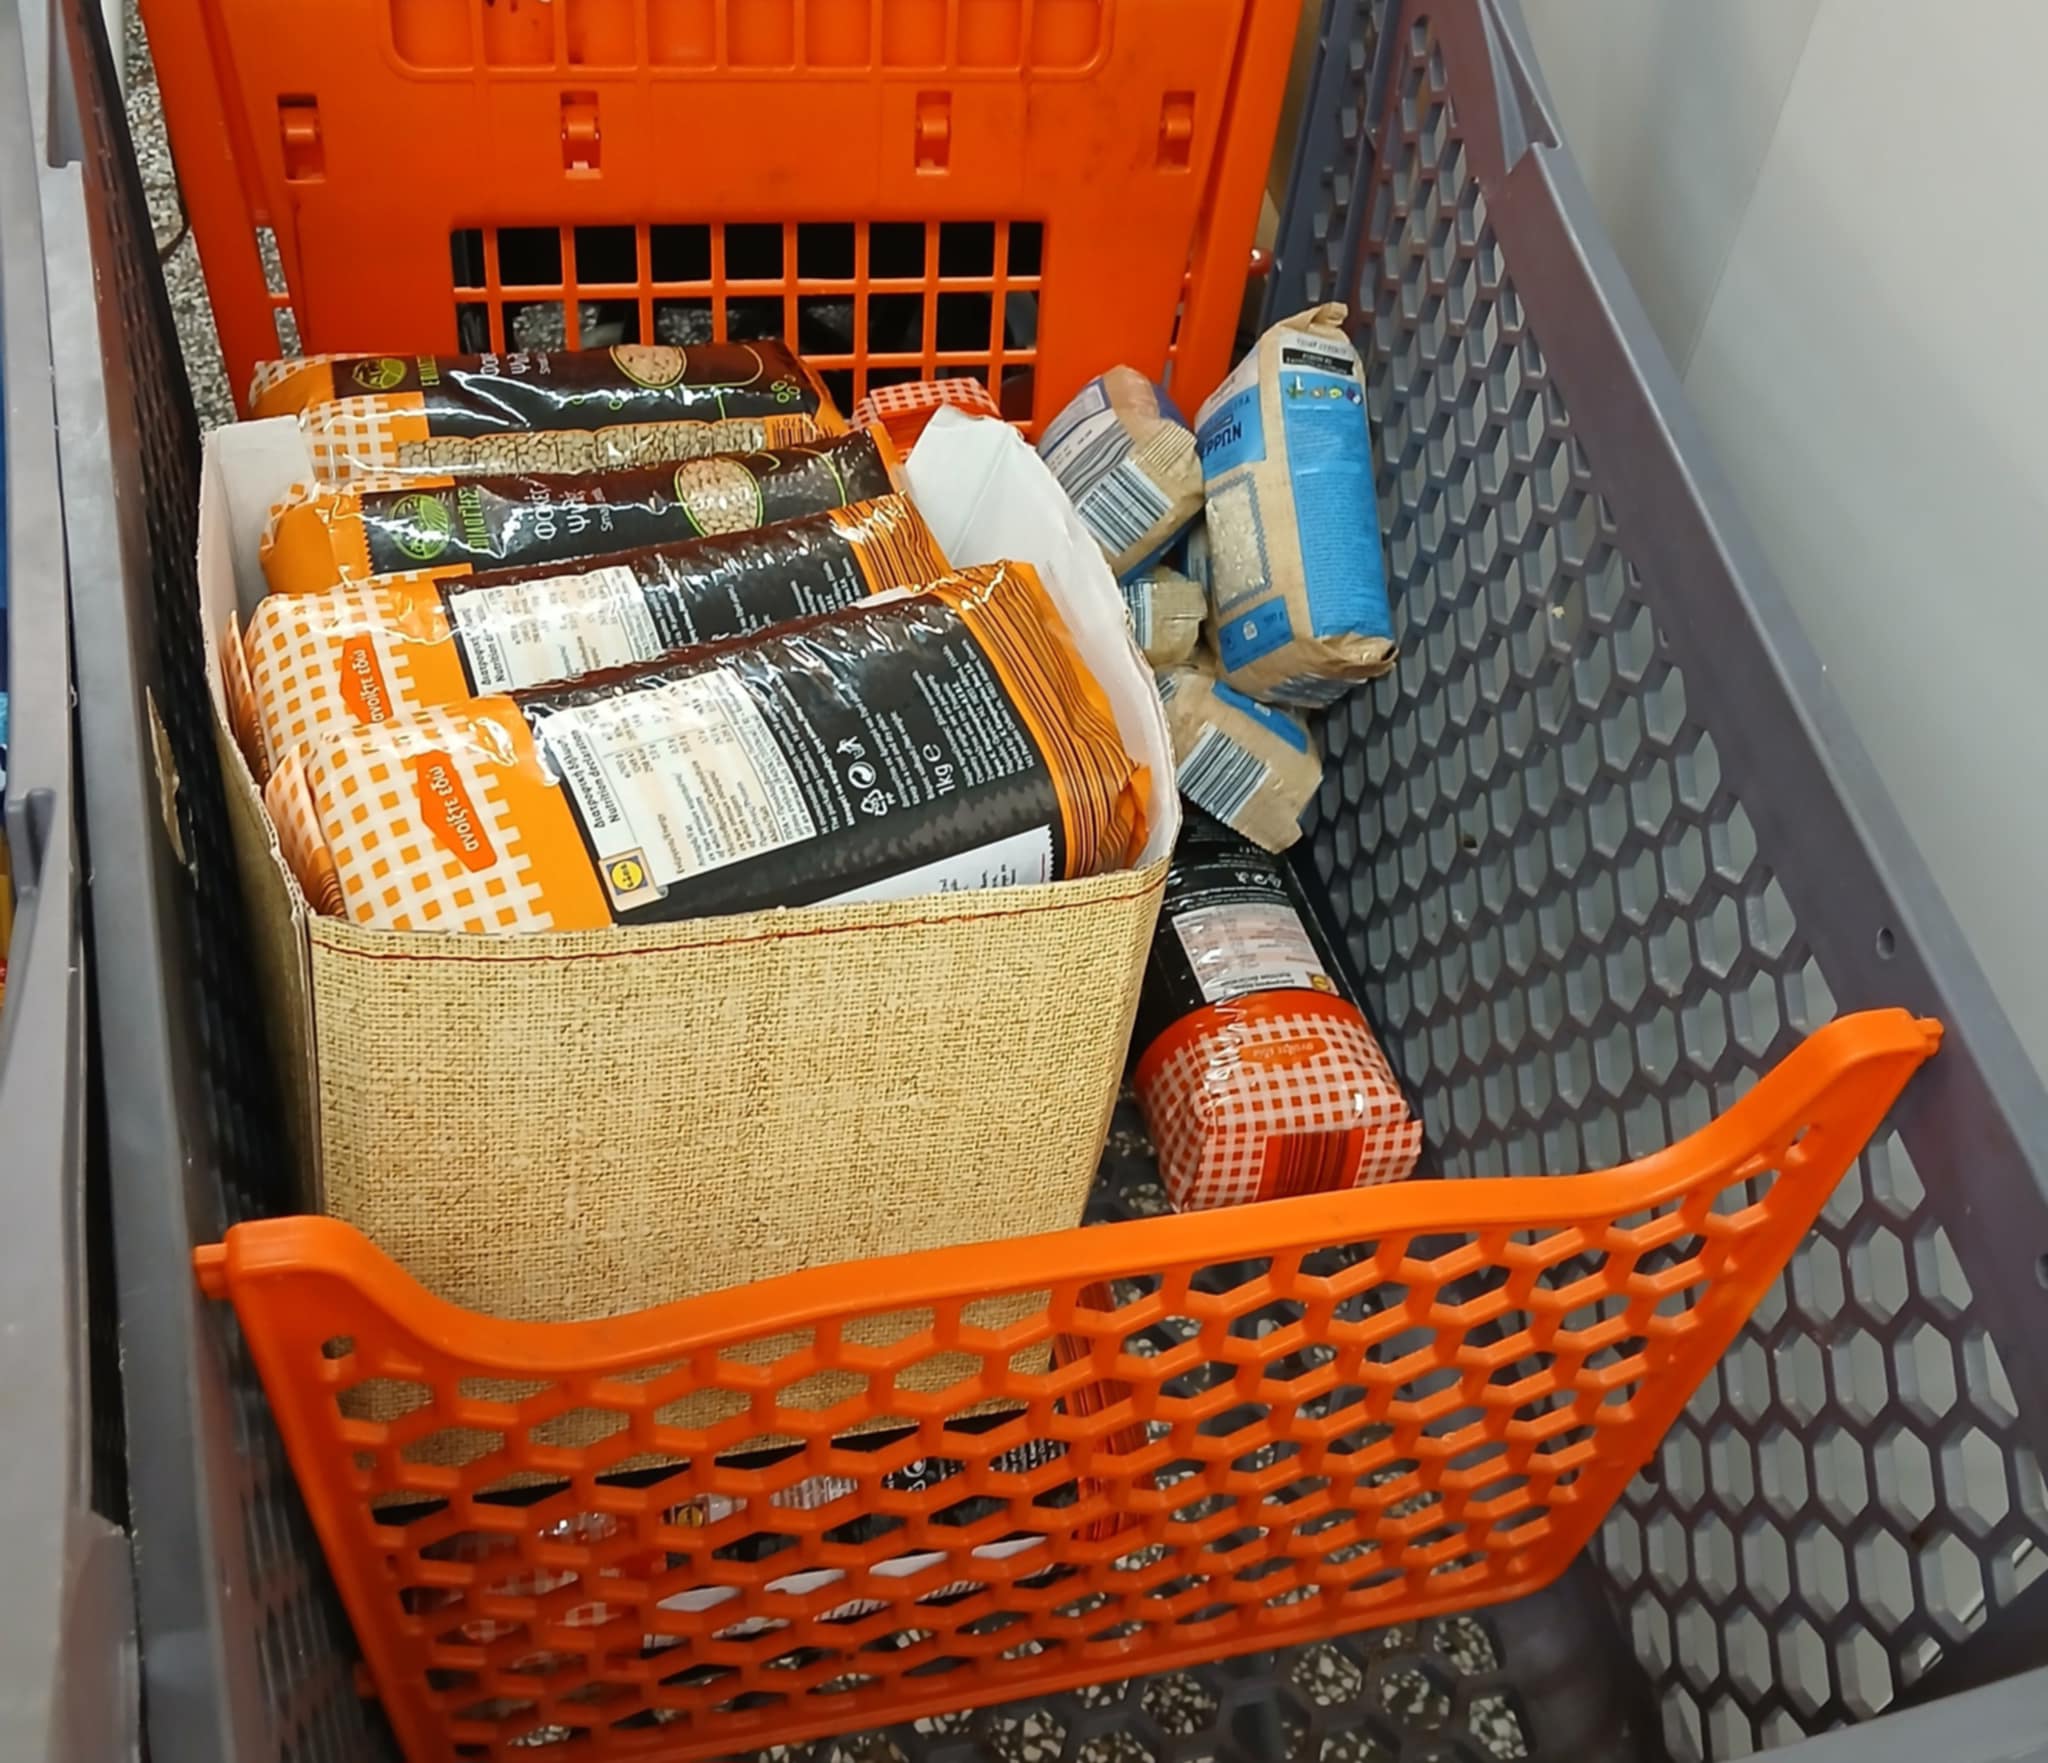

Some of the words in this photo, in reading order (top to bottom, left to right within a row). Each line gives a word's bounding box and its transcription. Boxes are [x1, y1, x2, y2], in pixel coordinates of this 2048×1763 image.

[570, 729, 601, 778] declaration
[427, 766, 453, 794] εδώ
[932, 761, 956, 796] 1kg
[593, 778, 621, 823] Nutrition
